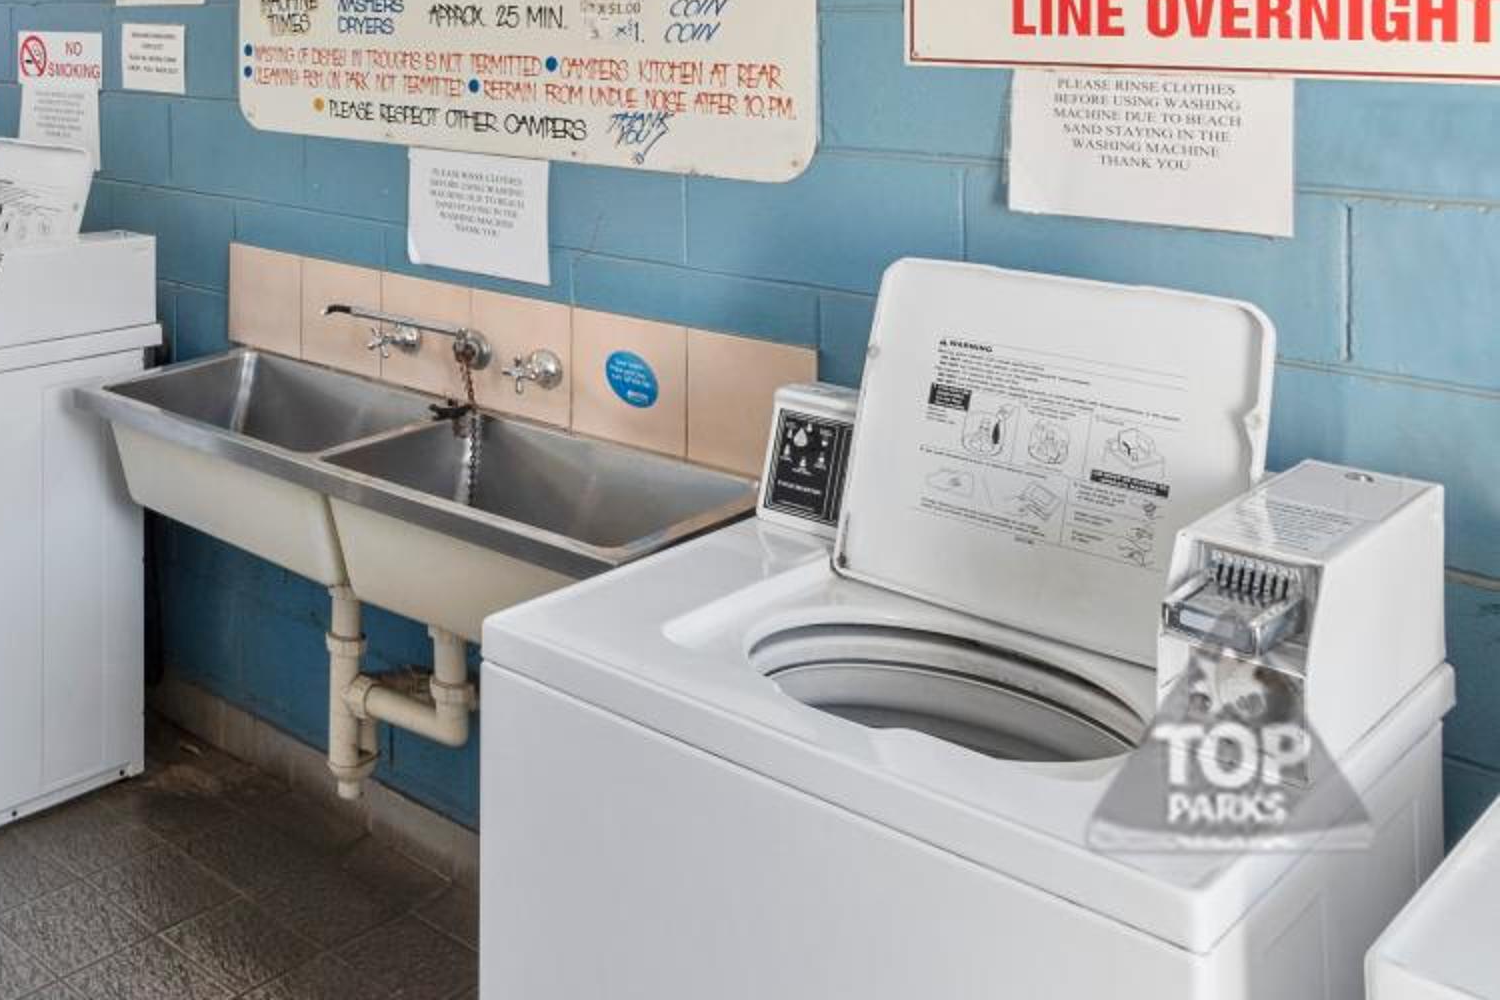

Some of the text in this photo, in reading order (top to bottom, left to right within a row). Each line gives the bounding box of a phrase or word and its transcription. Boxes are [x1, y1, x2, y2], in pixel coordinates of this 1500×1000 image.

[268, 13, 311, 33] TIMES
[337, 16, 396, 35] DRYERS
[495, 4, 520, 28] 25
[663, 21, 721, 44] COIN
[64, 40, 84, 57] NO
[47, 62, 101, 79] SMOKING
[366, 49, 422, 69] TROUGHS
[440, 52, 462, 73] NOT
[560, 57, 629, 82] CAMPERS
[638, 60, 704, 85] KITCHEN
[709, 62, 732, 87] AT
[737, 63, 783, 90] REAR
[375, 72, 397, 92] NOT
[483, 79, 536, 102] REFRAIN
[545, 82, 583, 104] FROM
[589, 85, 639, 109] UNDUE
[645, 88, 687, 113] NOISE
[1057, 78, 1237, 96] PLEASE RINSE CLOTHES
[1053, 93, 1242, 112] BEFORE USING WASHING
[329, 100, 587, 141] PLEASE RESPECT OTHER CAMPERS
[607, 110, 674, 134] THANK
[1052, 107, 1242, 127] MACHINE DUE TO BEACH
[1062, 122, 1231, 143] SAND STAYING IN THE
[1072, 139, 1220, 158] WASHING MACHINE
[1099, 155, 1191, 171] THANK YOU
[949, 340, 993, 352] WARNING
